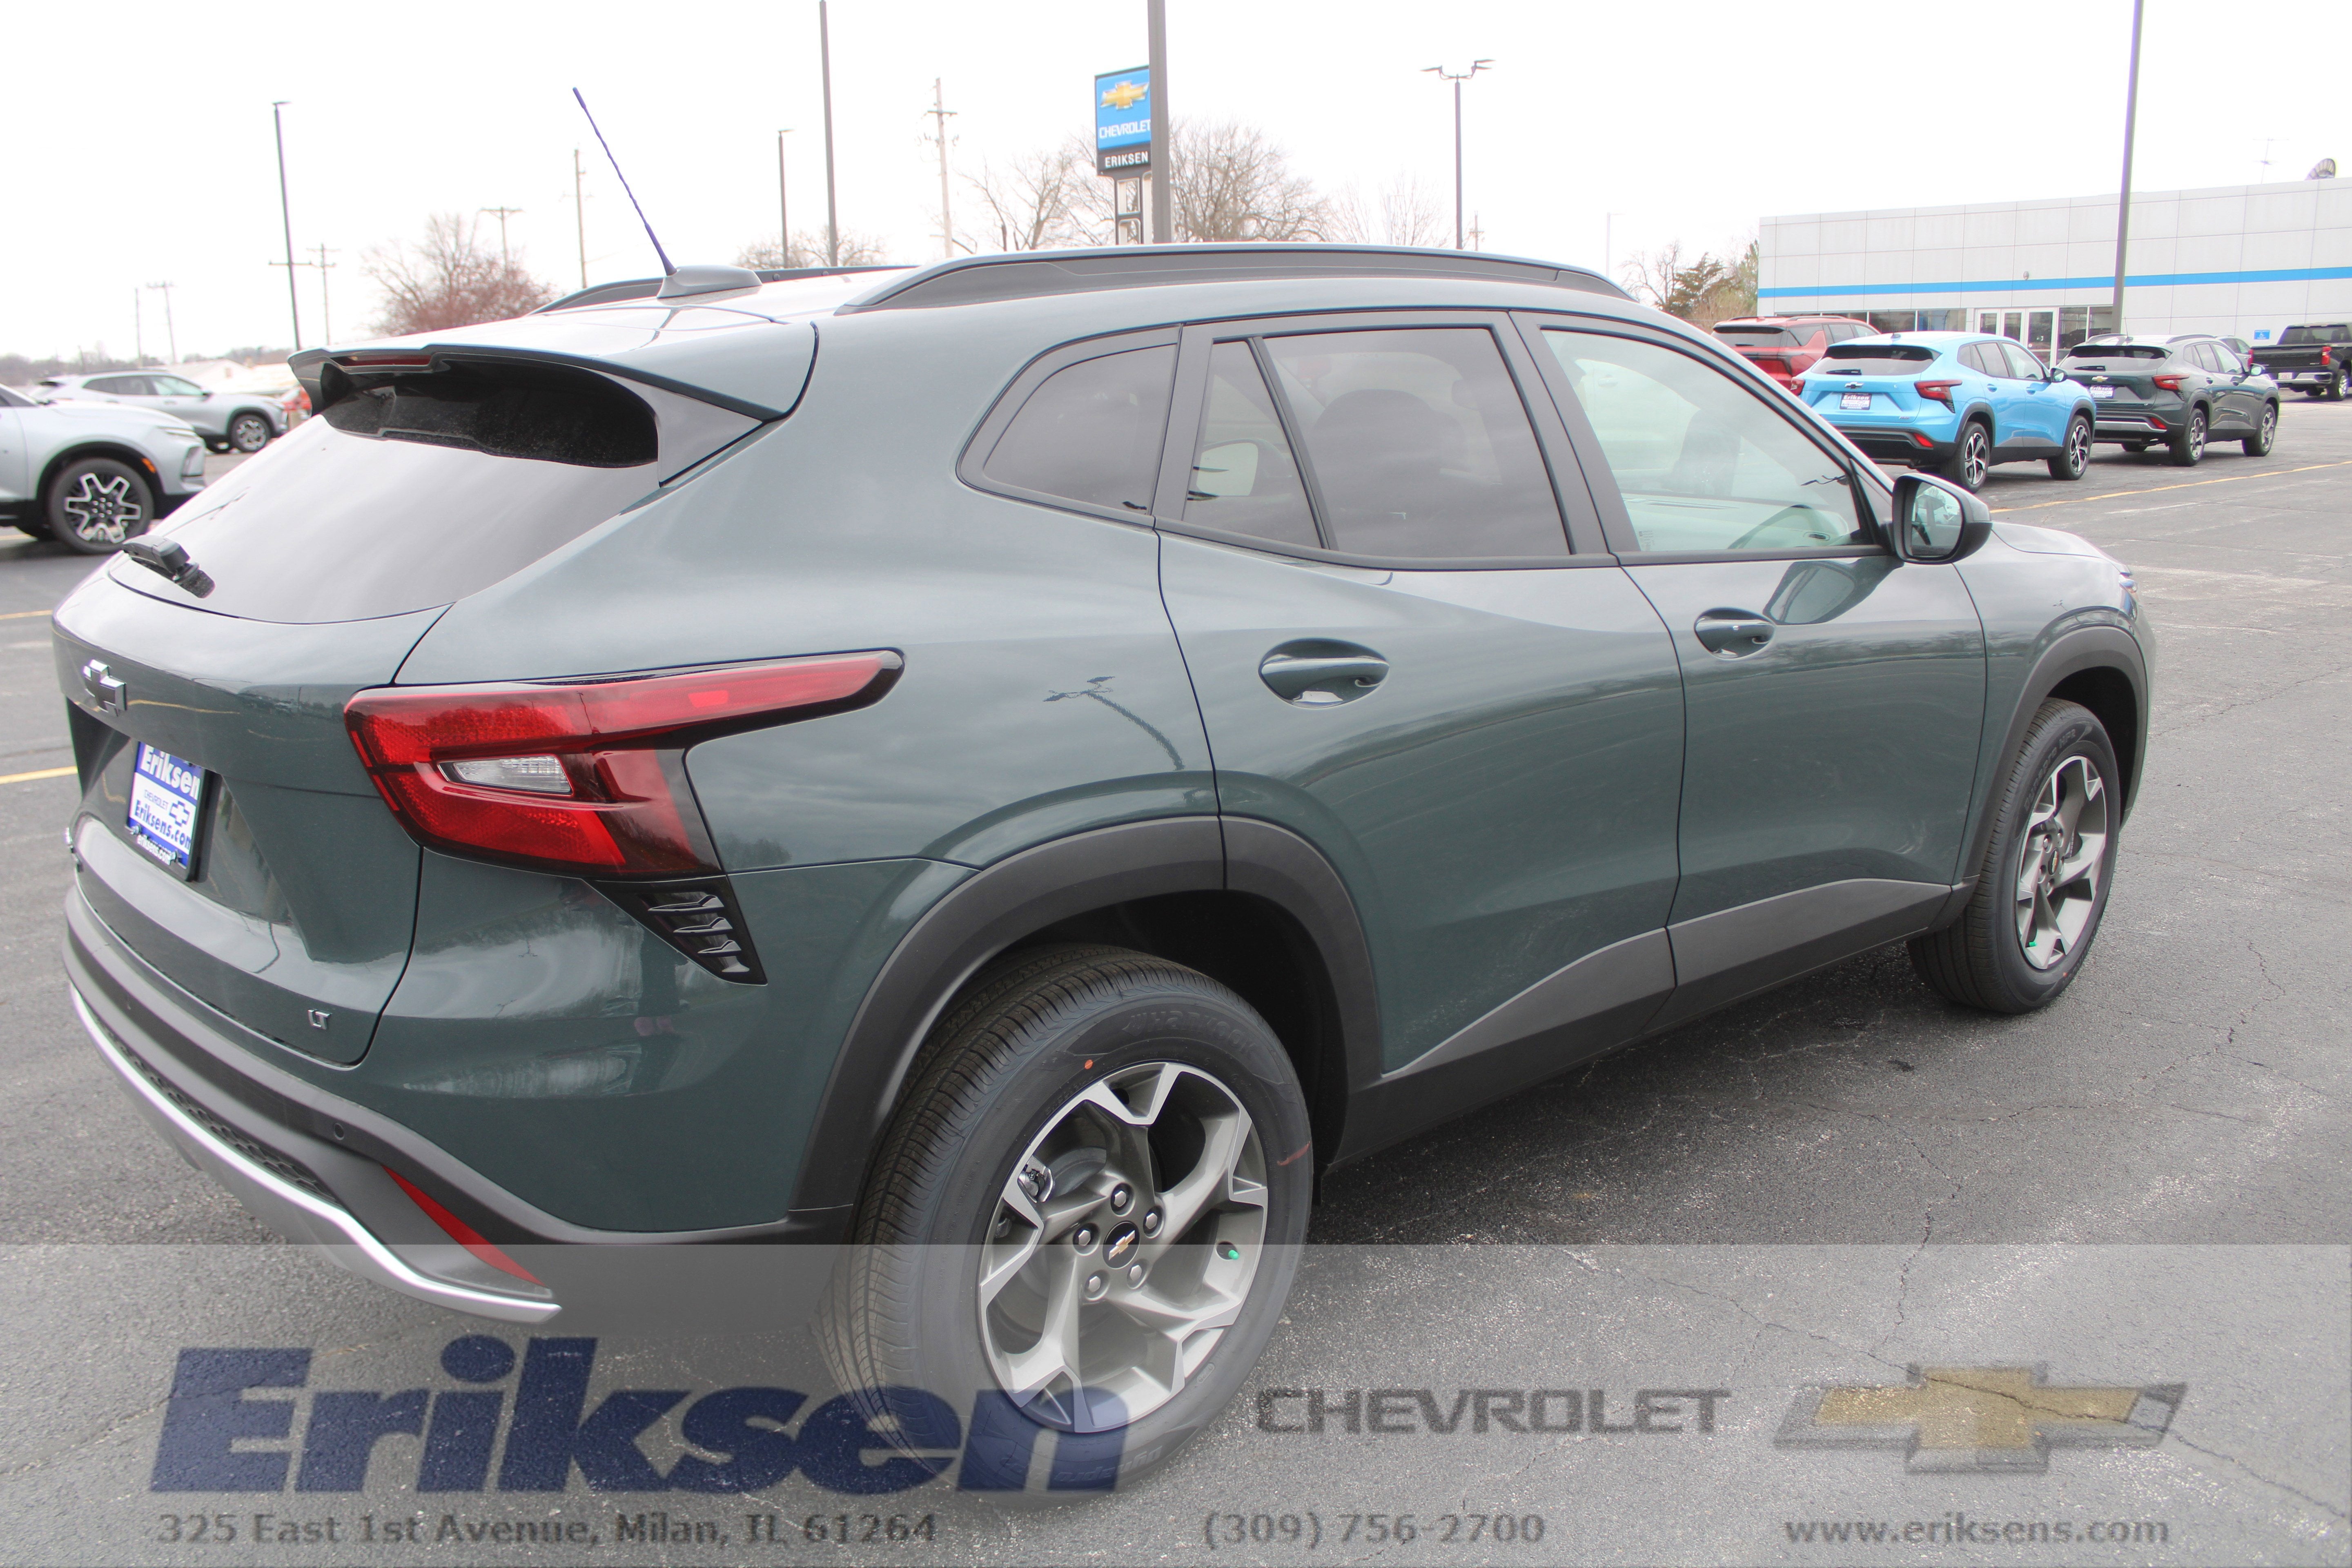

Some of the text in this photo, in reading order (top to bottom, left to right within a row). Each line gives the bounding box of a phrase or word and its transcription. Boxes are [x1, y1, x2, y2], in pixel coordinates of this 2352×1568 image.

[1099, 119, 1151, 139] CHEVROLET
[1105, 151, 1149, 168] ERIKSEN
[141, 744, 200, 800] Eriksen
[144, 789, 168, 810] CHEVROLET
[307, 1009, 331, 1030] LT
